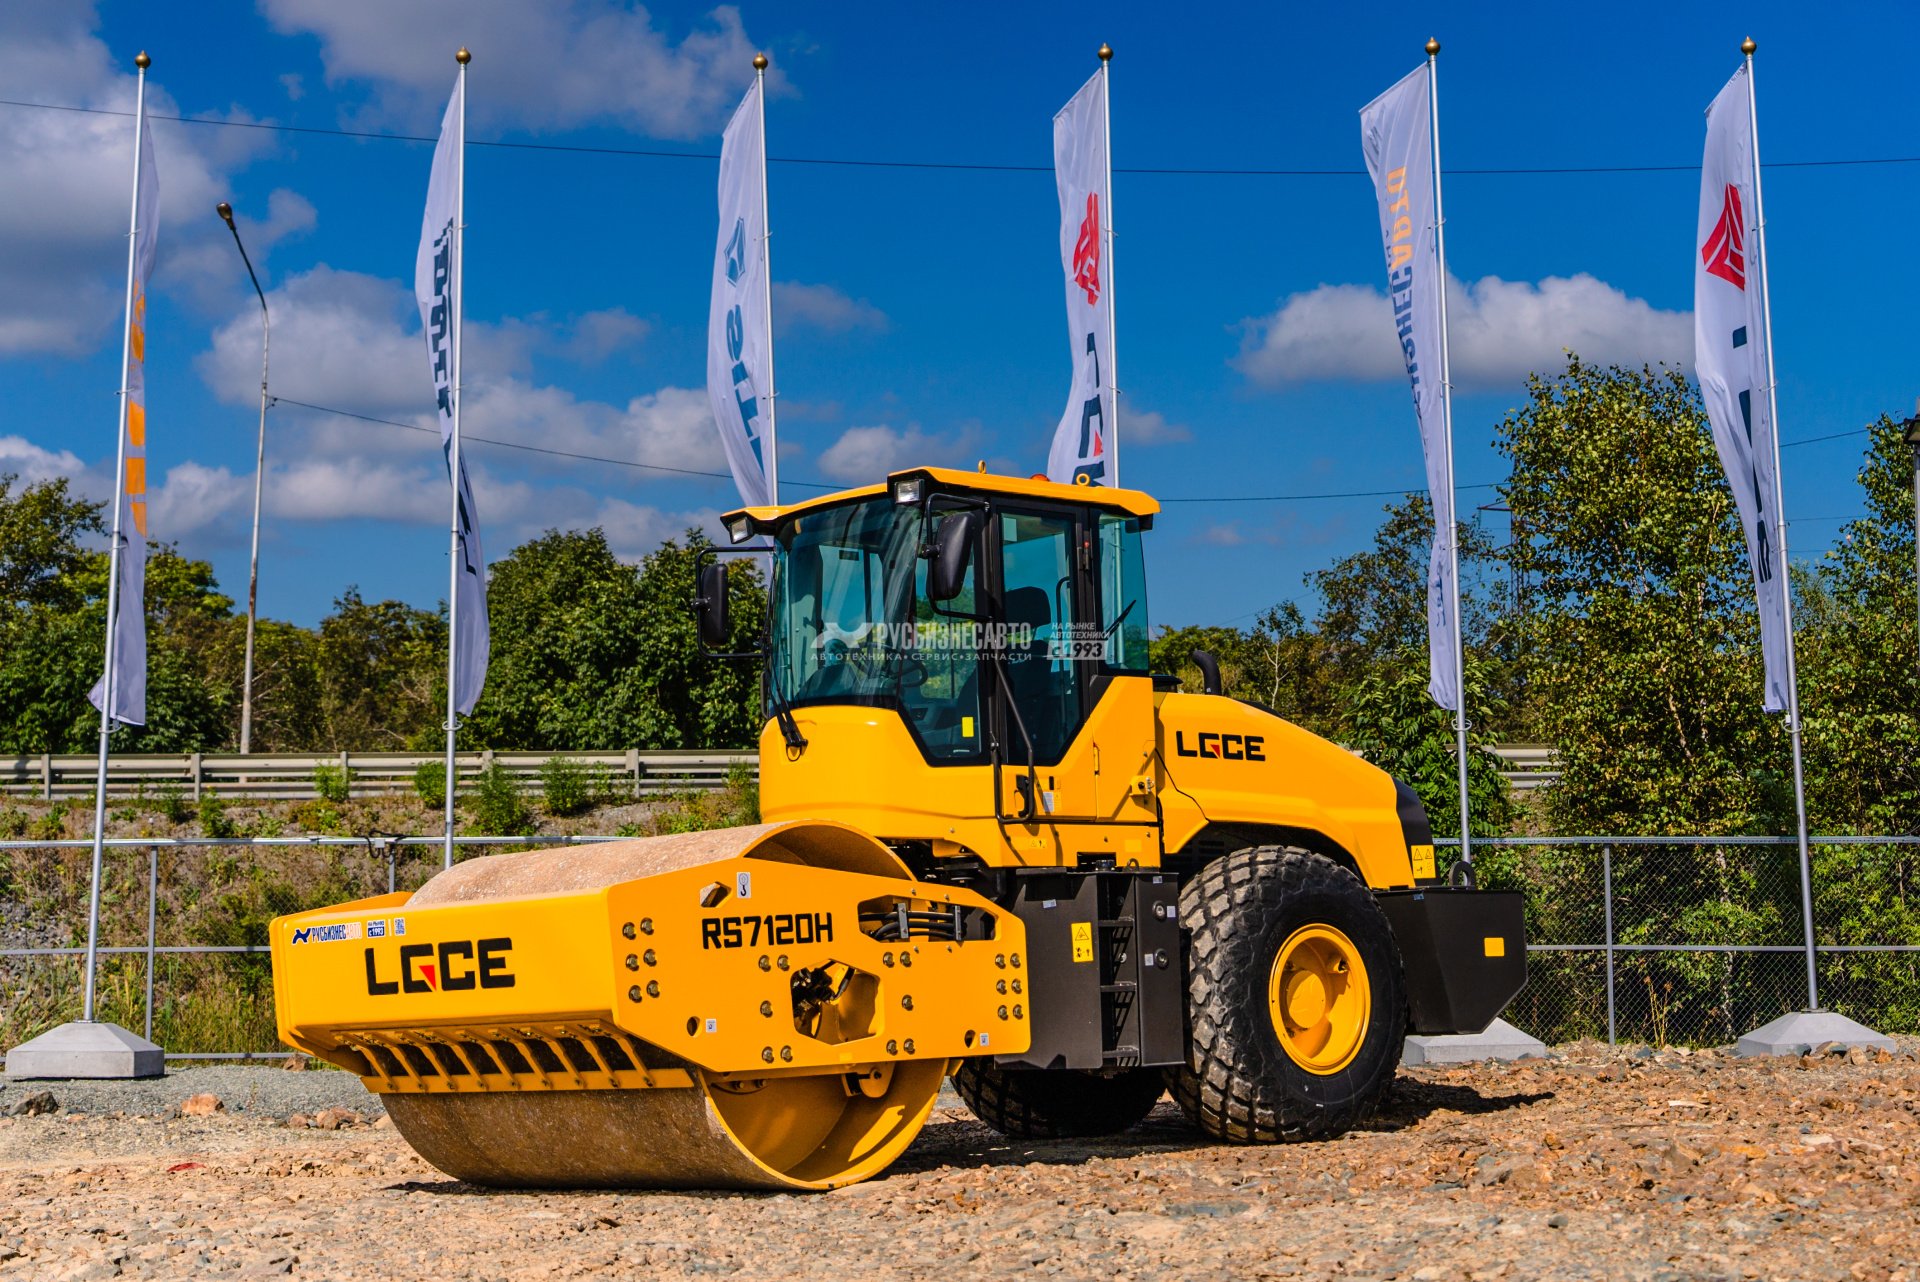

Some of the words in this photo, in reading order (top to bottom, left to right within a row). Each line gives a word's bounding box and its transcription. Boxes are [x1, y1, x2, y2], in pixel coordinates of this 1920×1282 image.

[1176, 731, 1265, 761] LGCE
[702, 912, 833, 949] RS7120H
[365, 937, 515, 995] LGCE
